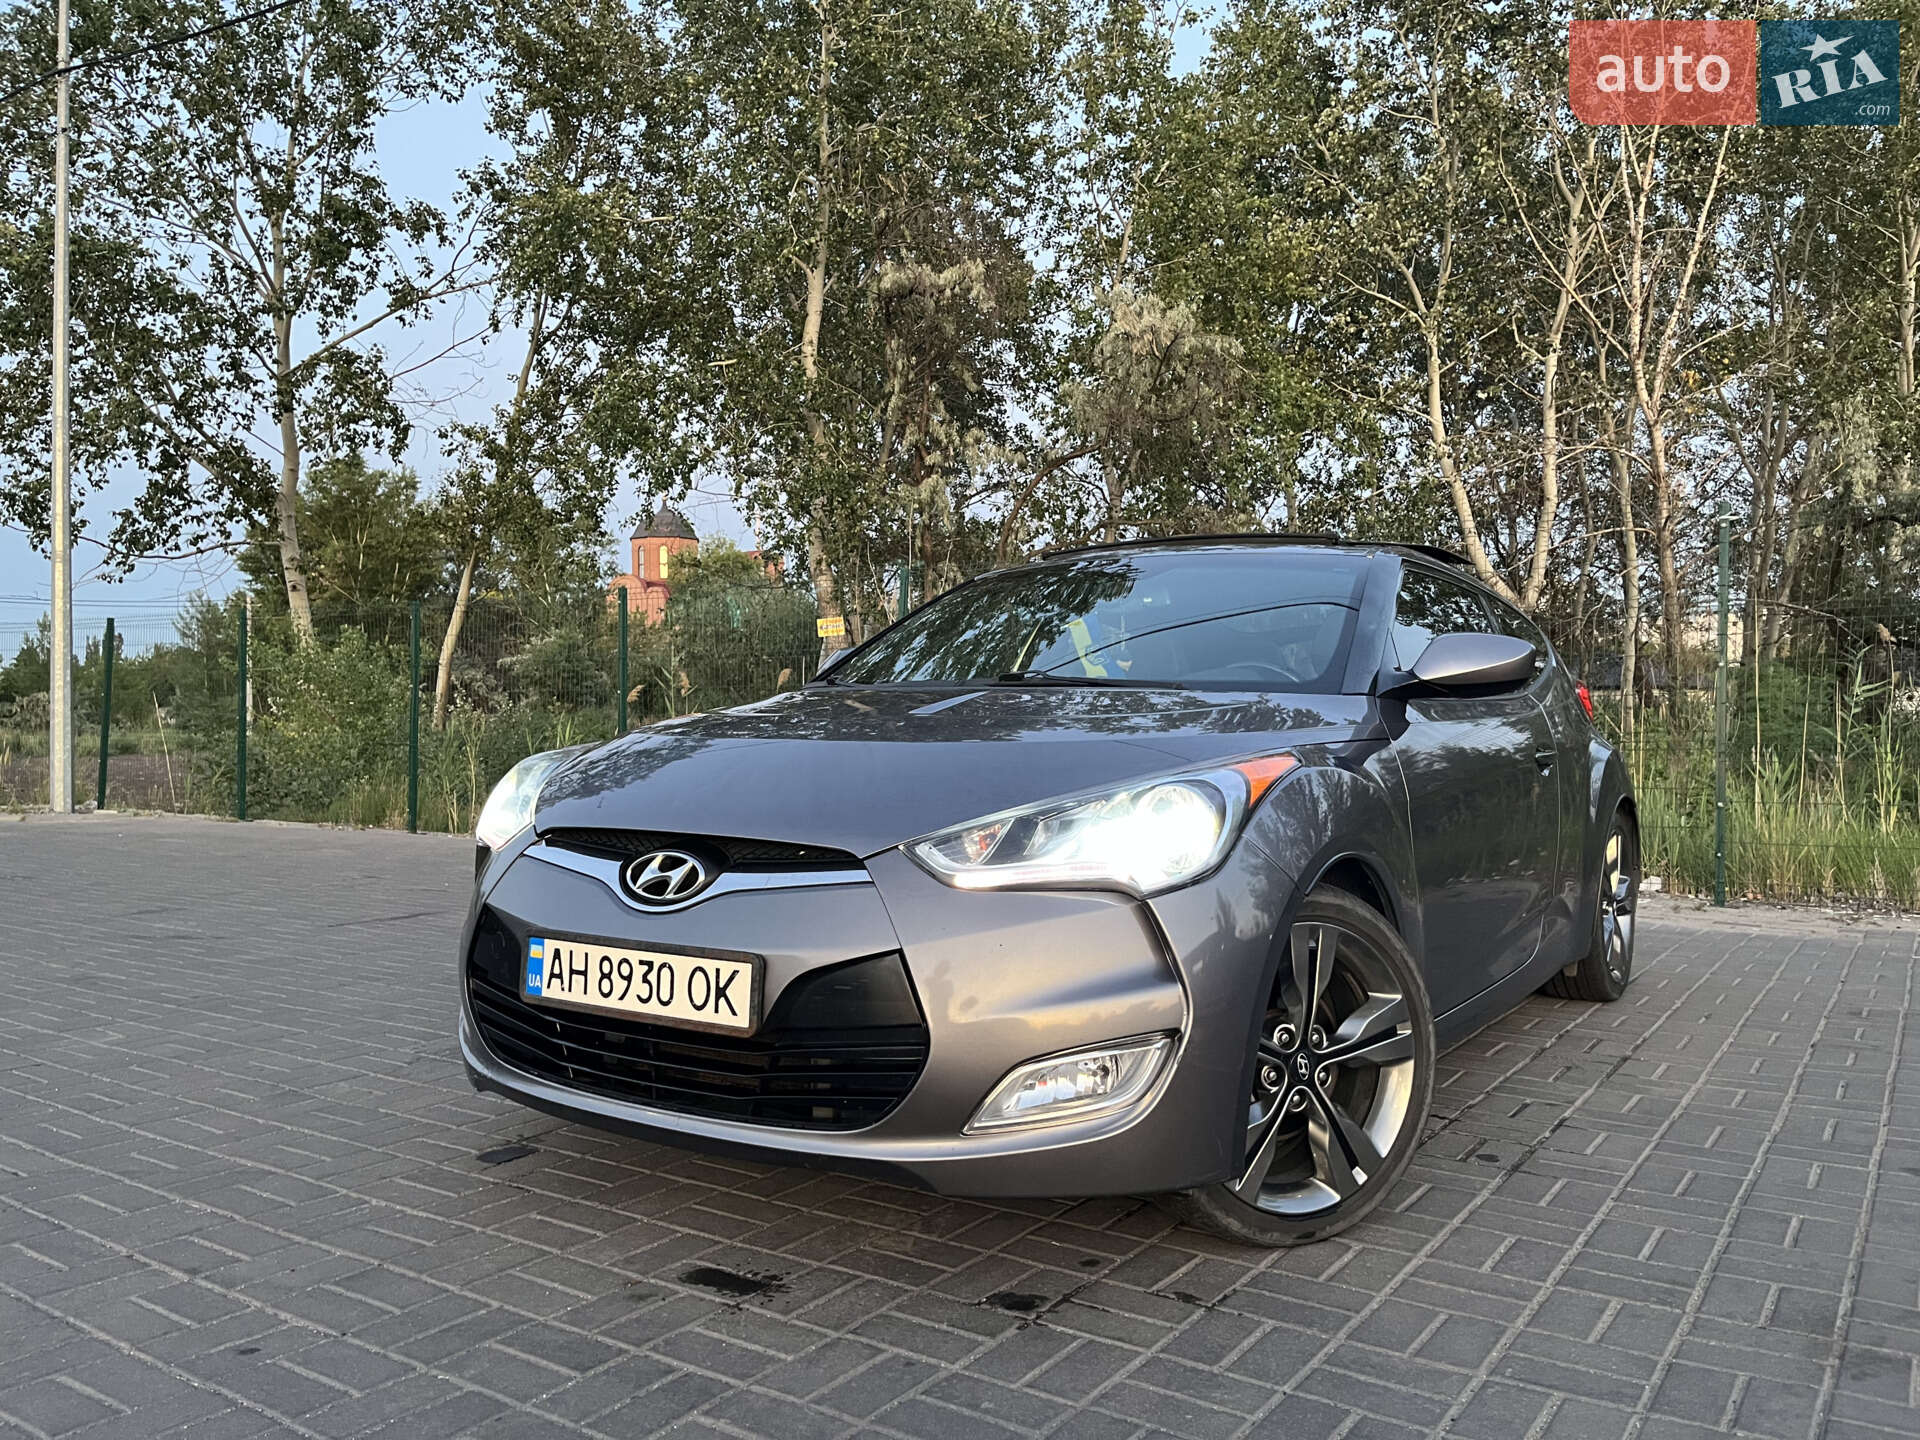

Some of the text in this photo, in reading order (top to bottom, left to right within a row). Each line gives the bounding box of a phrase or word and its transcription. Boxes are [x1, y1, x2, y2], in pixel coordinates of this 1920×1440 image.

[528, 973, 542, 988] UA
[547, 947, 741, 1016] AH 8930 OK
